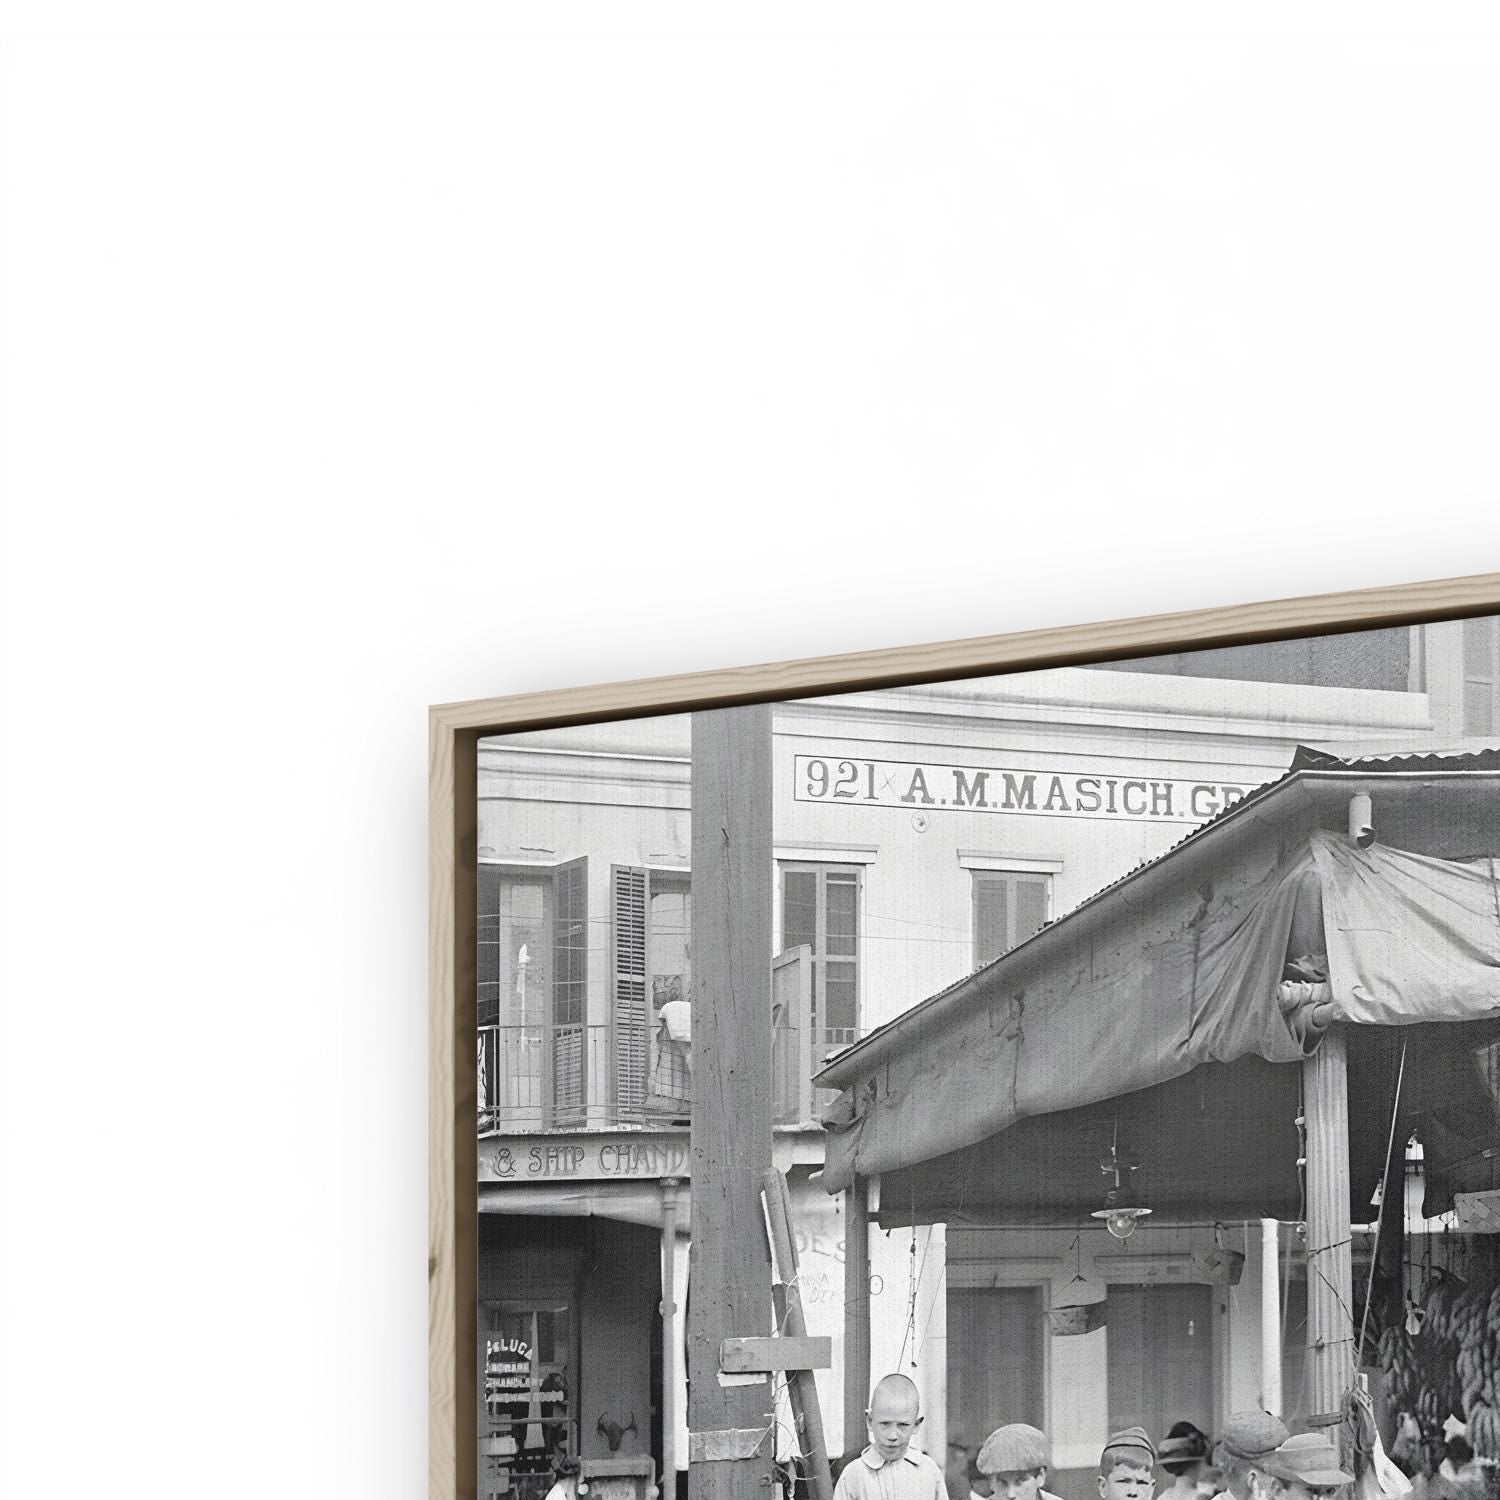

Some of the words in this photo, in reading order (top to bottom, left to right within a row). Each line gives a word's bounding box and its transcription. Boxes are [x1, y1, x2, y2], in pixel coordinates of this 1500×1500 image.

[806, 759, 880, 801] 921
[491, 1147, 518, 1178] &
[526, 1145, 586, 1177] SHIP
